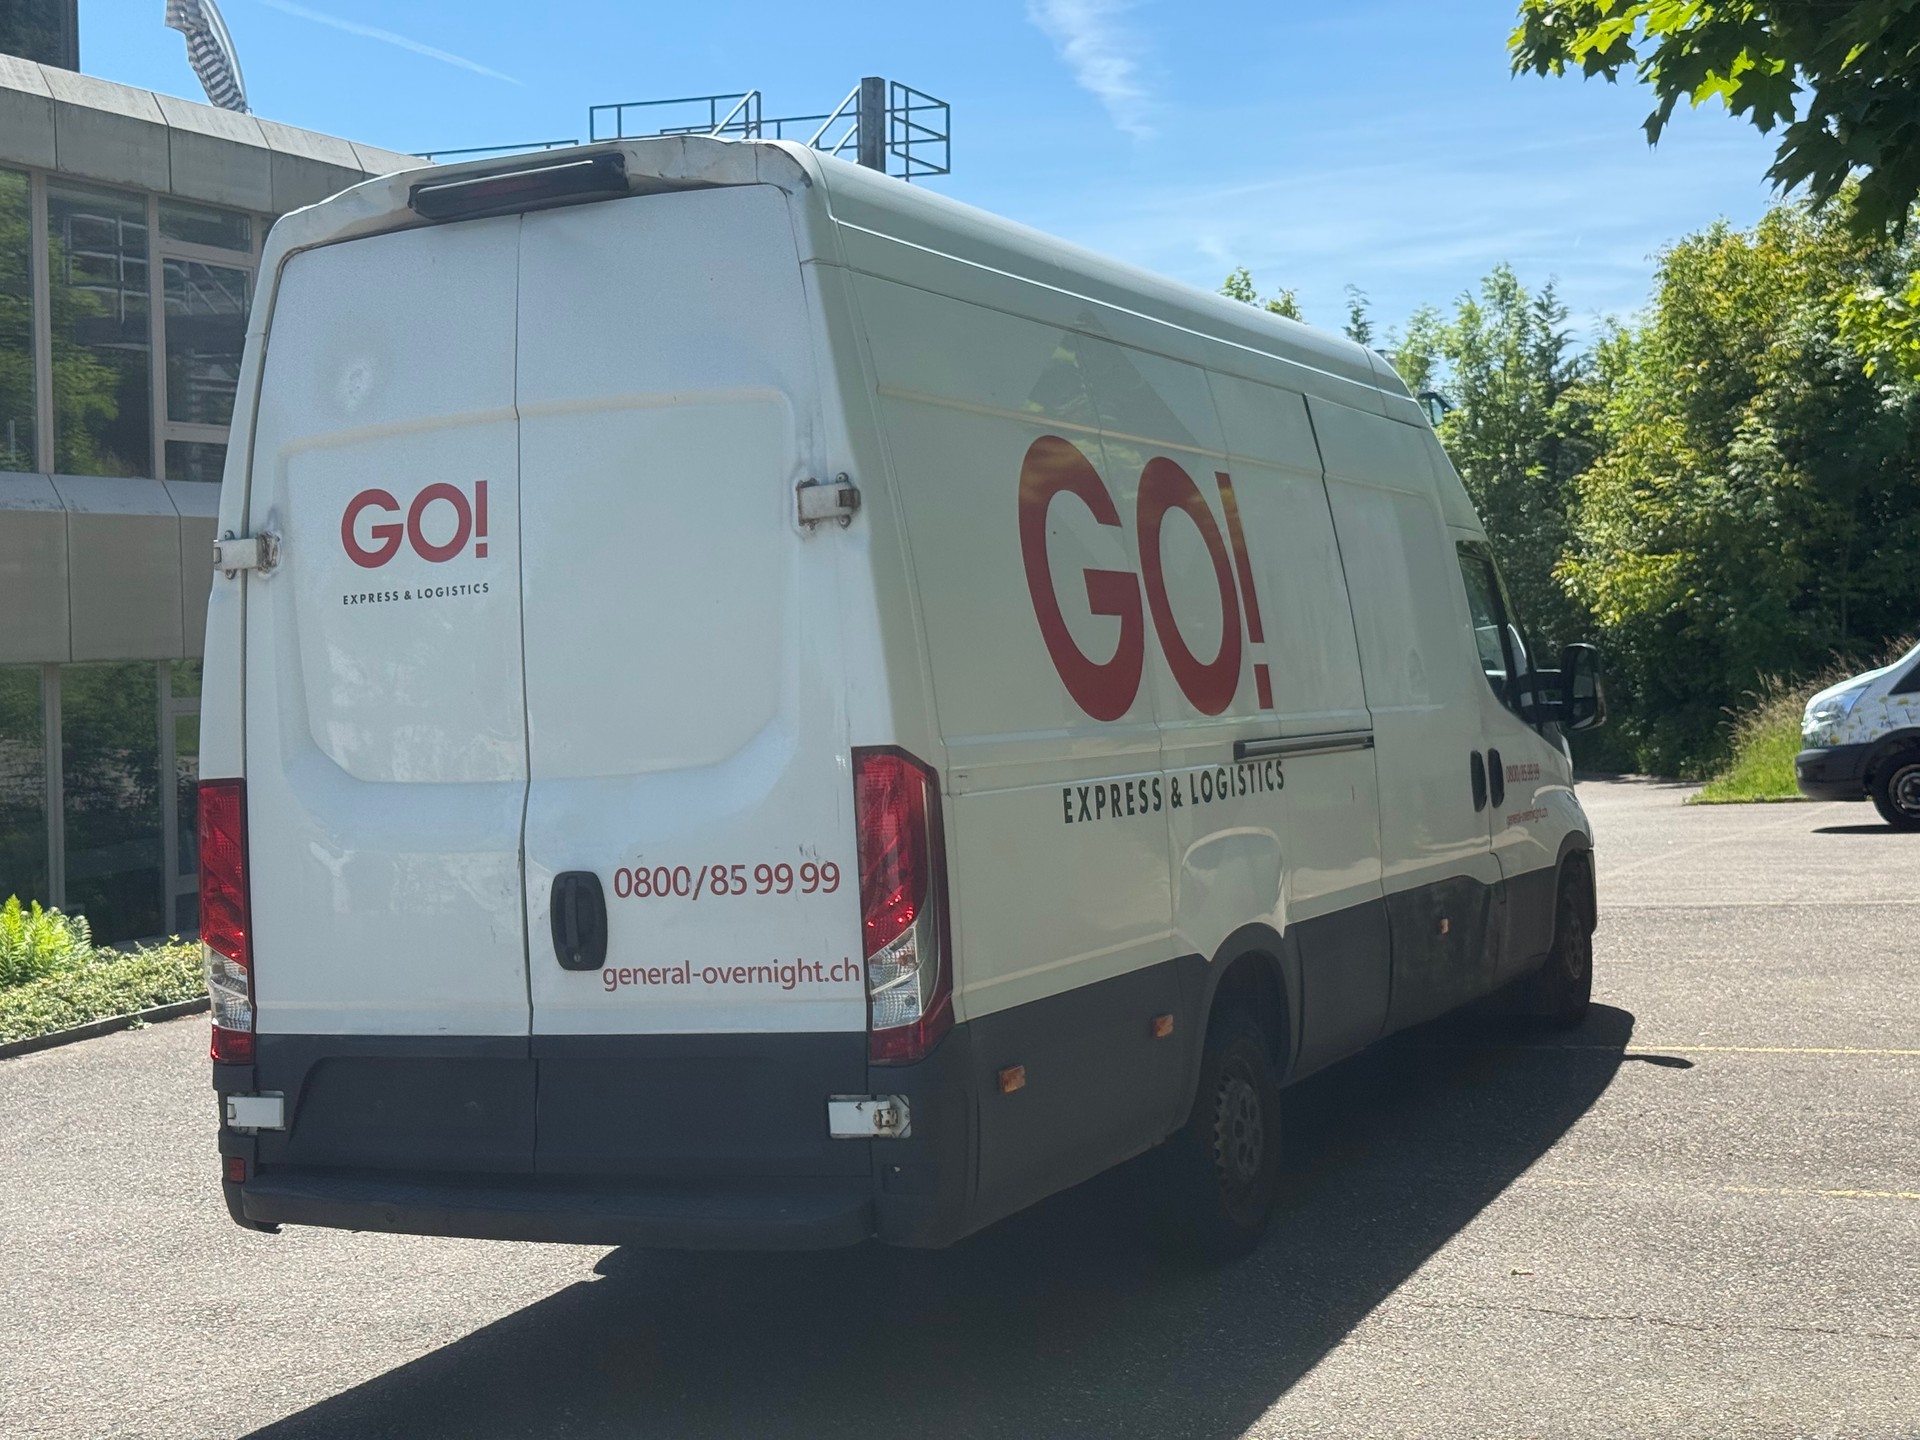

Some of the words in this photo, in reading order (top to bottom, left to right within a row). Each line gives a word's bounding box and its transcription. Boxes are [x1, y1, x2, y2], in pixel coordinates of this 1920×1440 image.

[341, 480, 488, 568] GO!
[343, 590, 399, 605] EXPRESS
[403, 590, 412, 600] &
[417, 582, 489, 599] LOGISTICS
[1018, 434, 1274, 722] GO!
[1062, 777, 1163, 824] EXPRESS
[1170, 776, 1183, 809] &
[1189, 759, 1285, 805] LOGISTICS
[753, 863, 793, 894] 99
[800, 861, 840, 893] 99
[602, 957, 860, 992] general-overnight.ch
